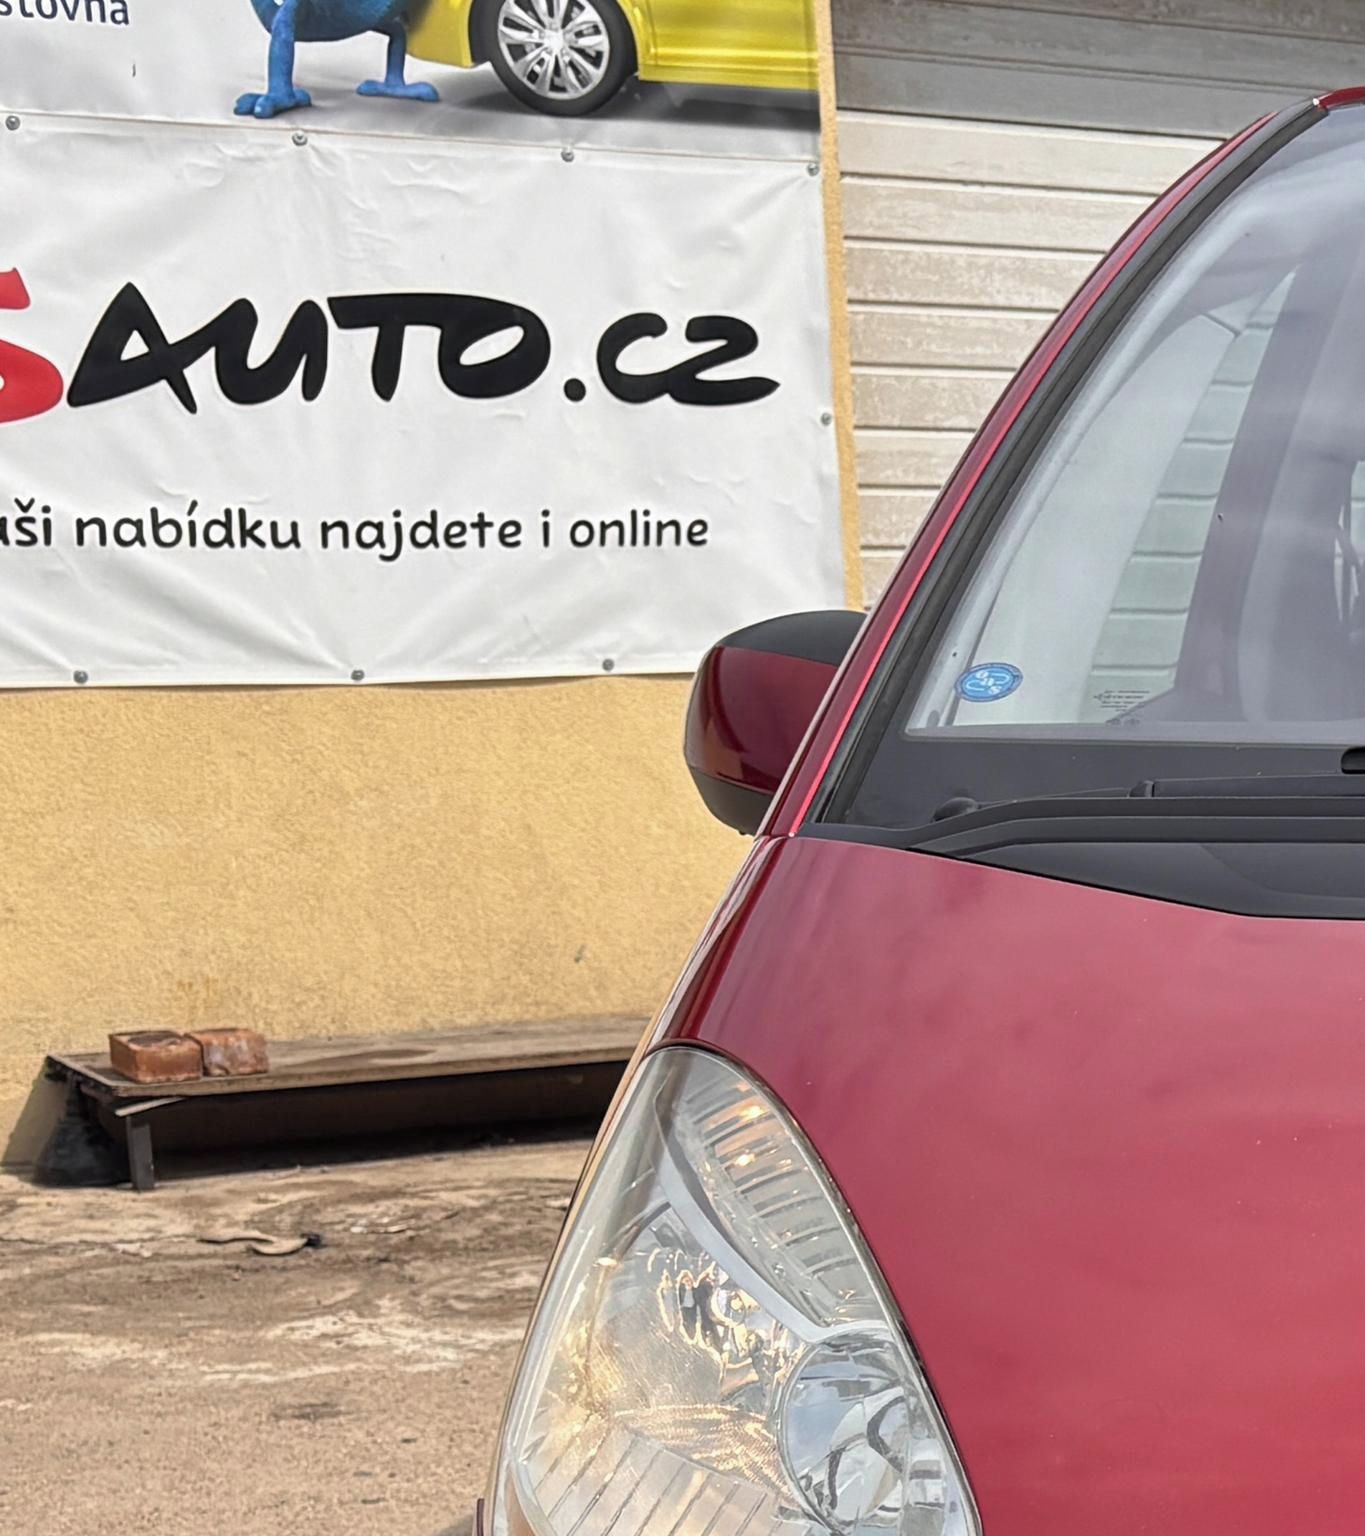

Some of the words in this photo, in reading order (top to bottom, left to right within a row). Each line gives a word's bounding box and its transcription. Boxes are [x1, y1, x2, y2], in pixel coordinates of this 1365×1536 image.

[76, 500, 301, 549] nabídku
[321, 509, 522, 562] najdete
[541, 509, 550, 548] i
[569, 509, 708, 548] online
